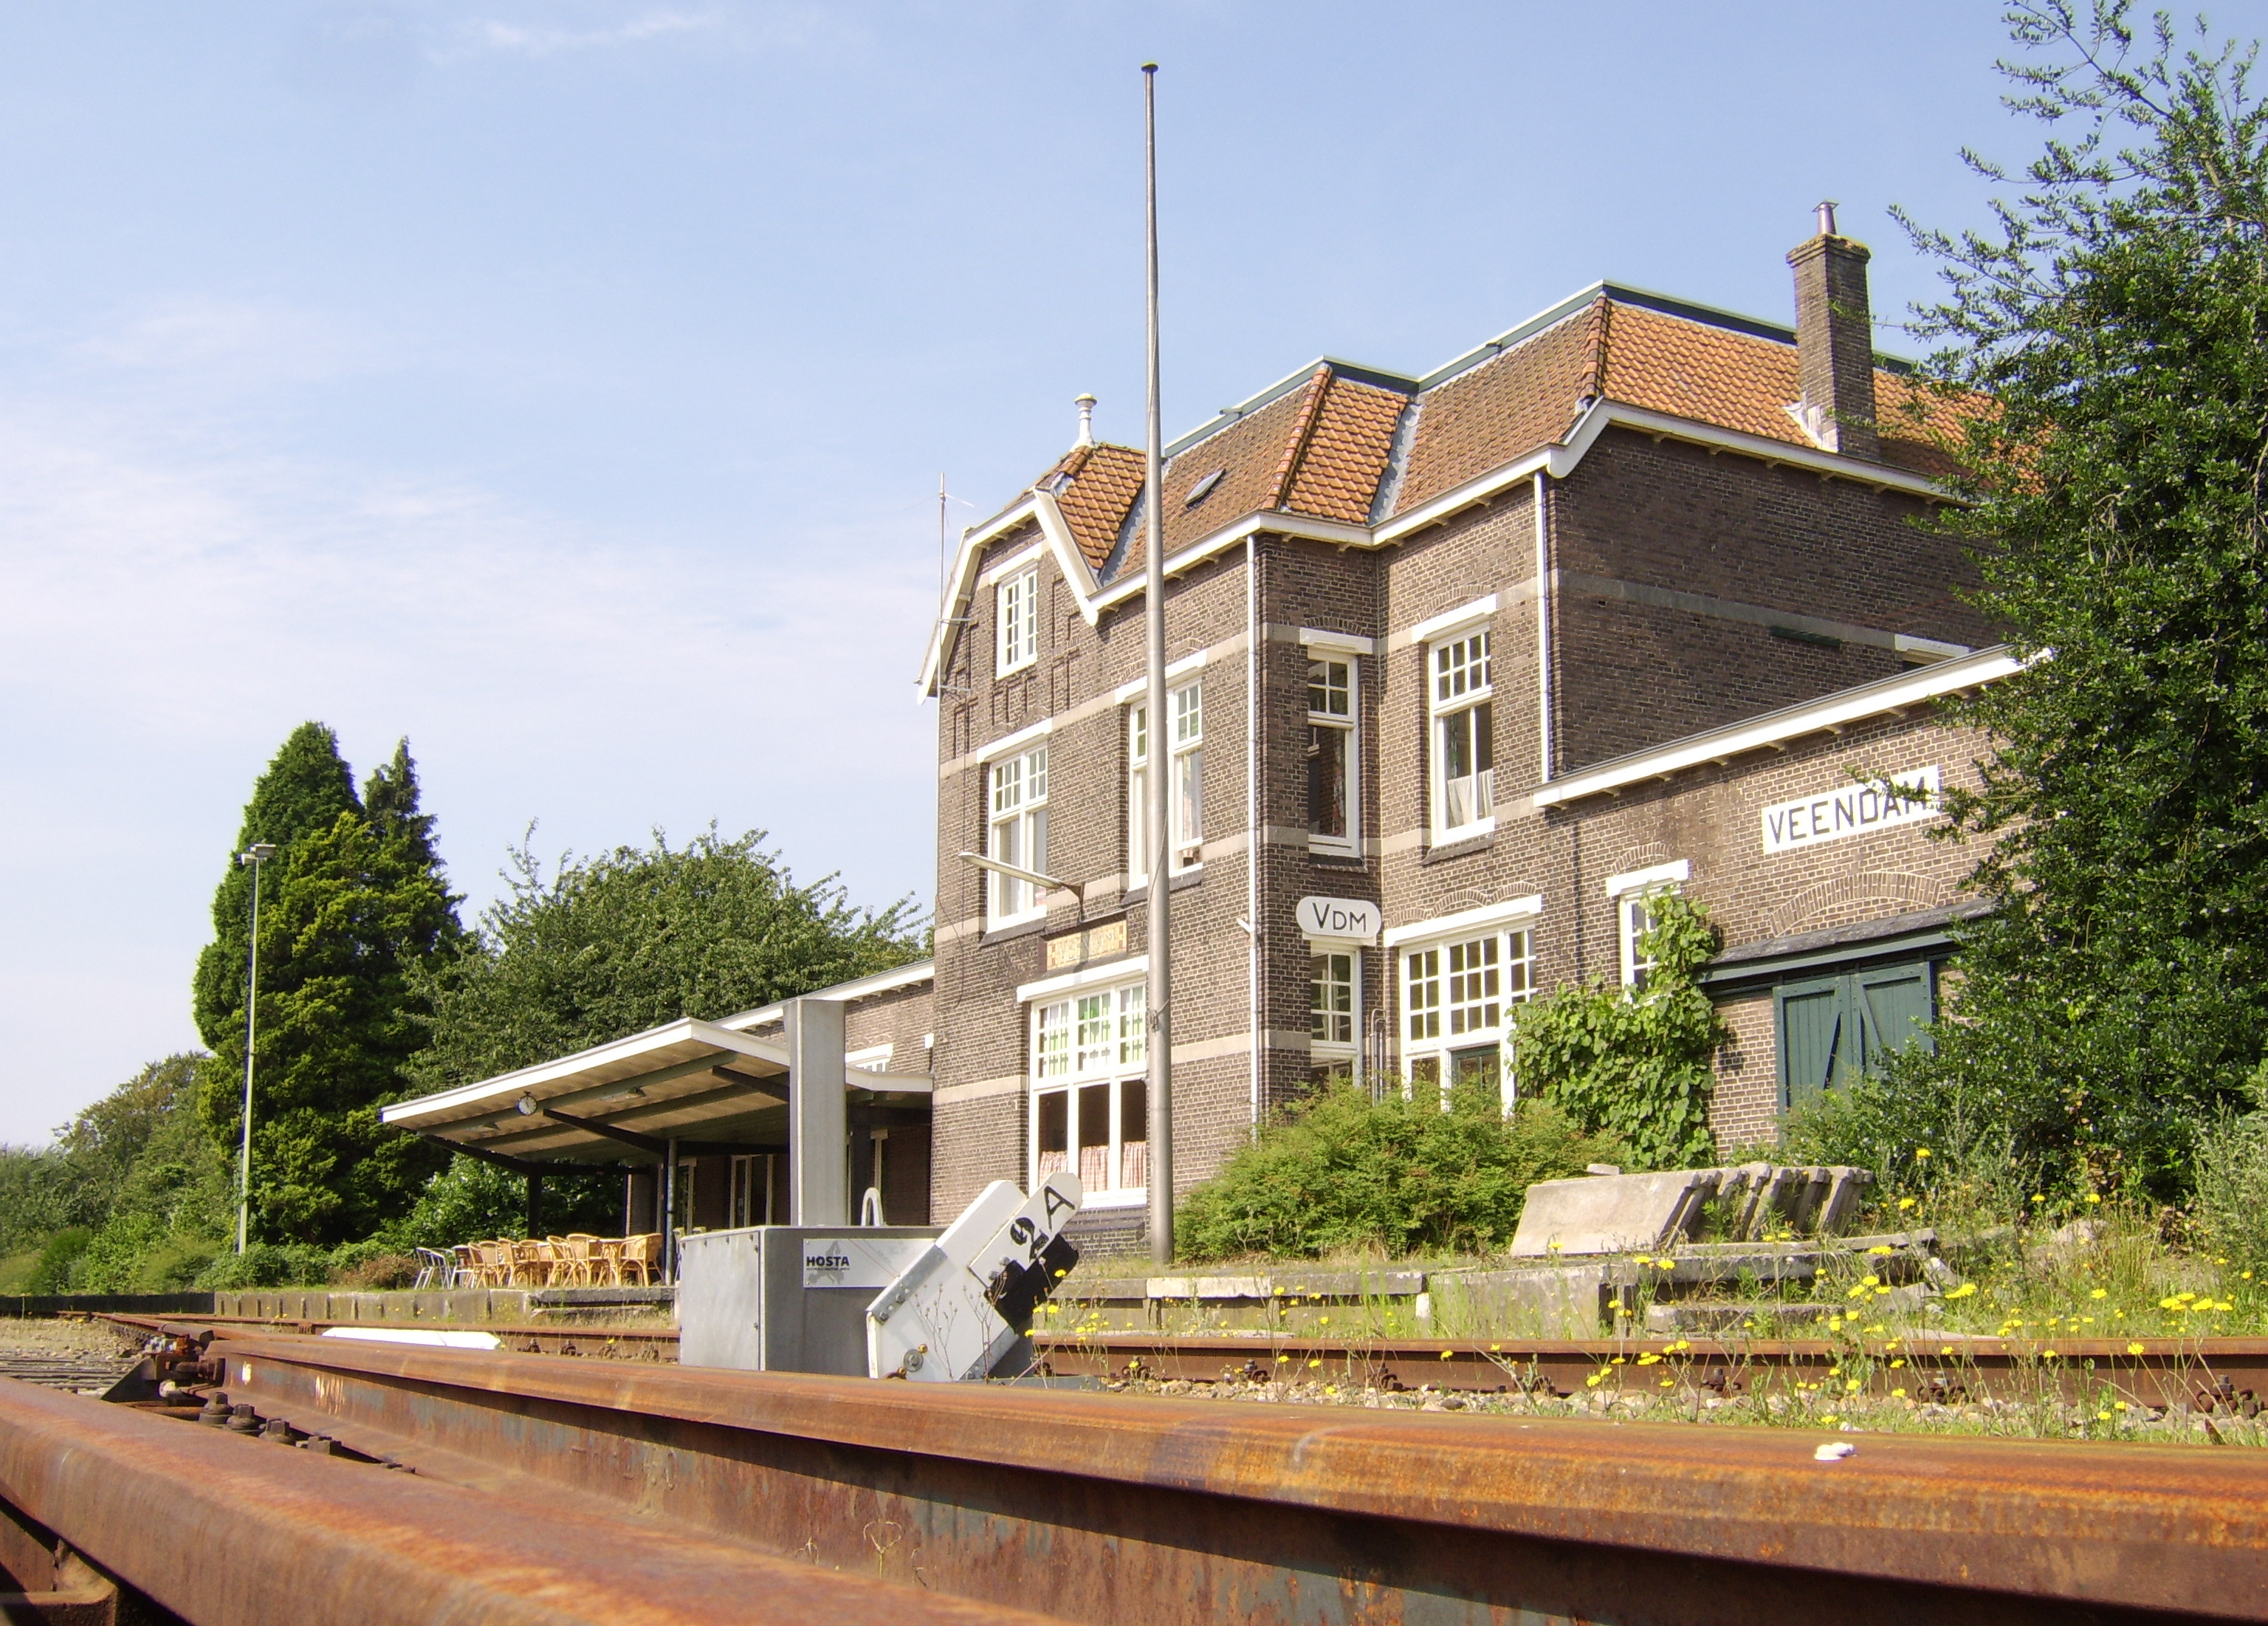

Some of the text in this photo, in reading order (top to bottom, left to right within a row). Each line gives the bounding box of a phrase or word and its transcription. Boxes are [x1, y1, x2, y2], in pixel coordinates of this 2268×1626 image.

[1769, 776, 1927, 844] VEENDAM
[1312, 902, 1367, 933] VDM
[806, 1256, 850, 1266] HOSTA
